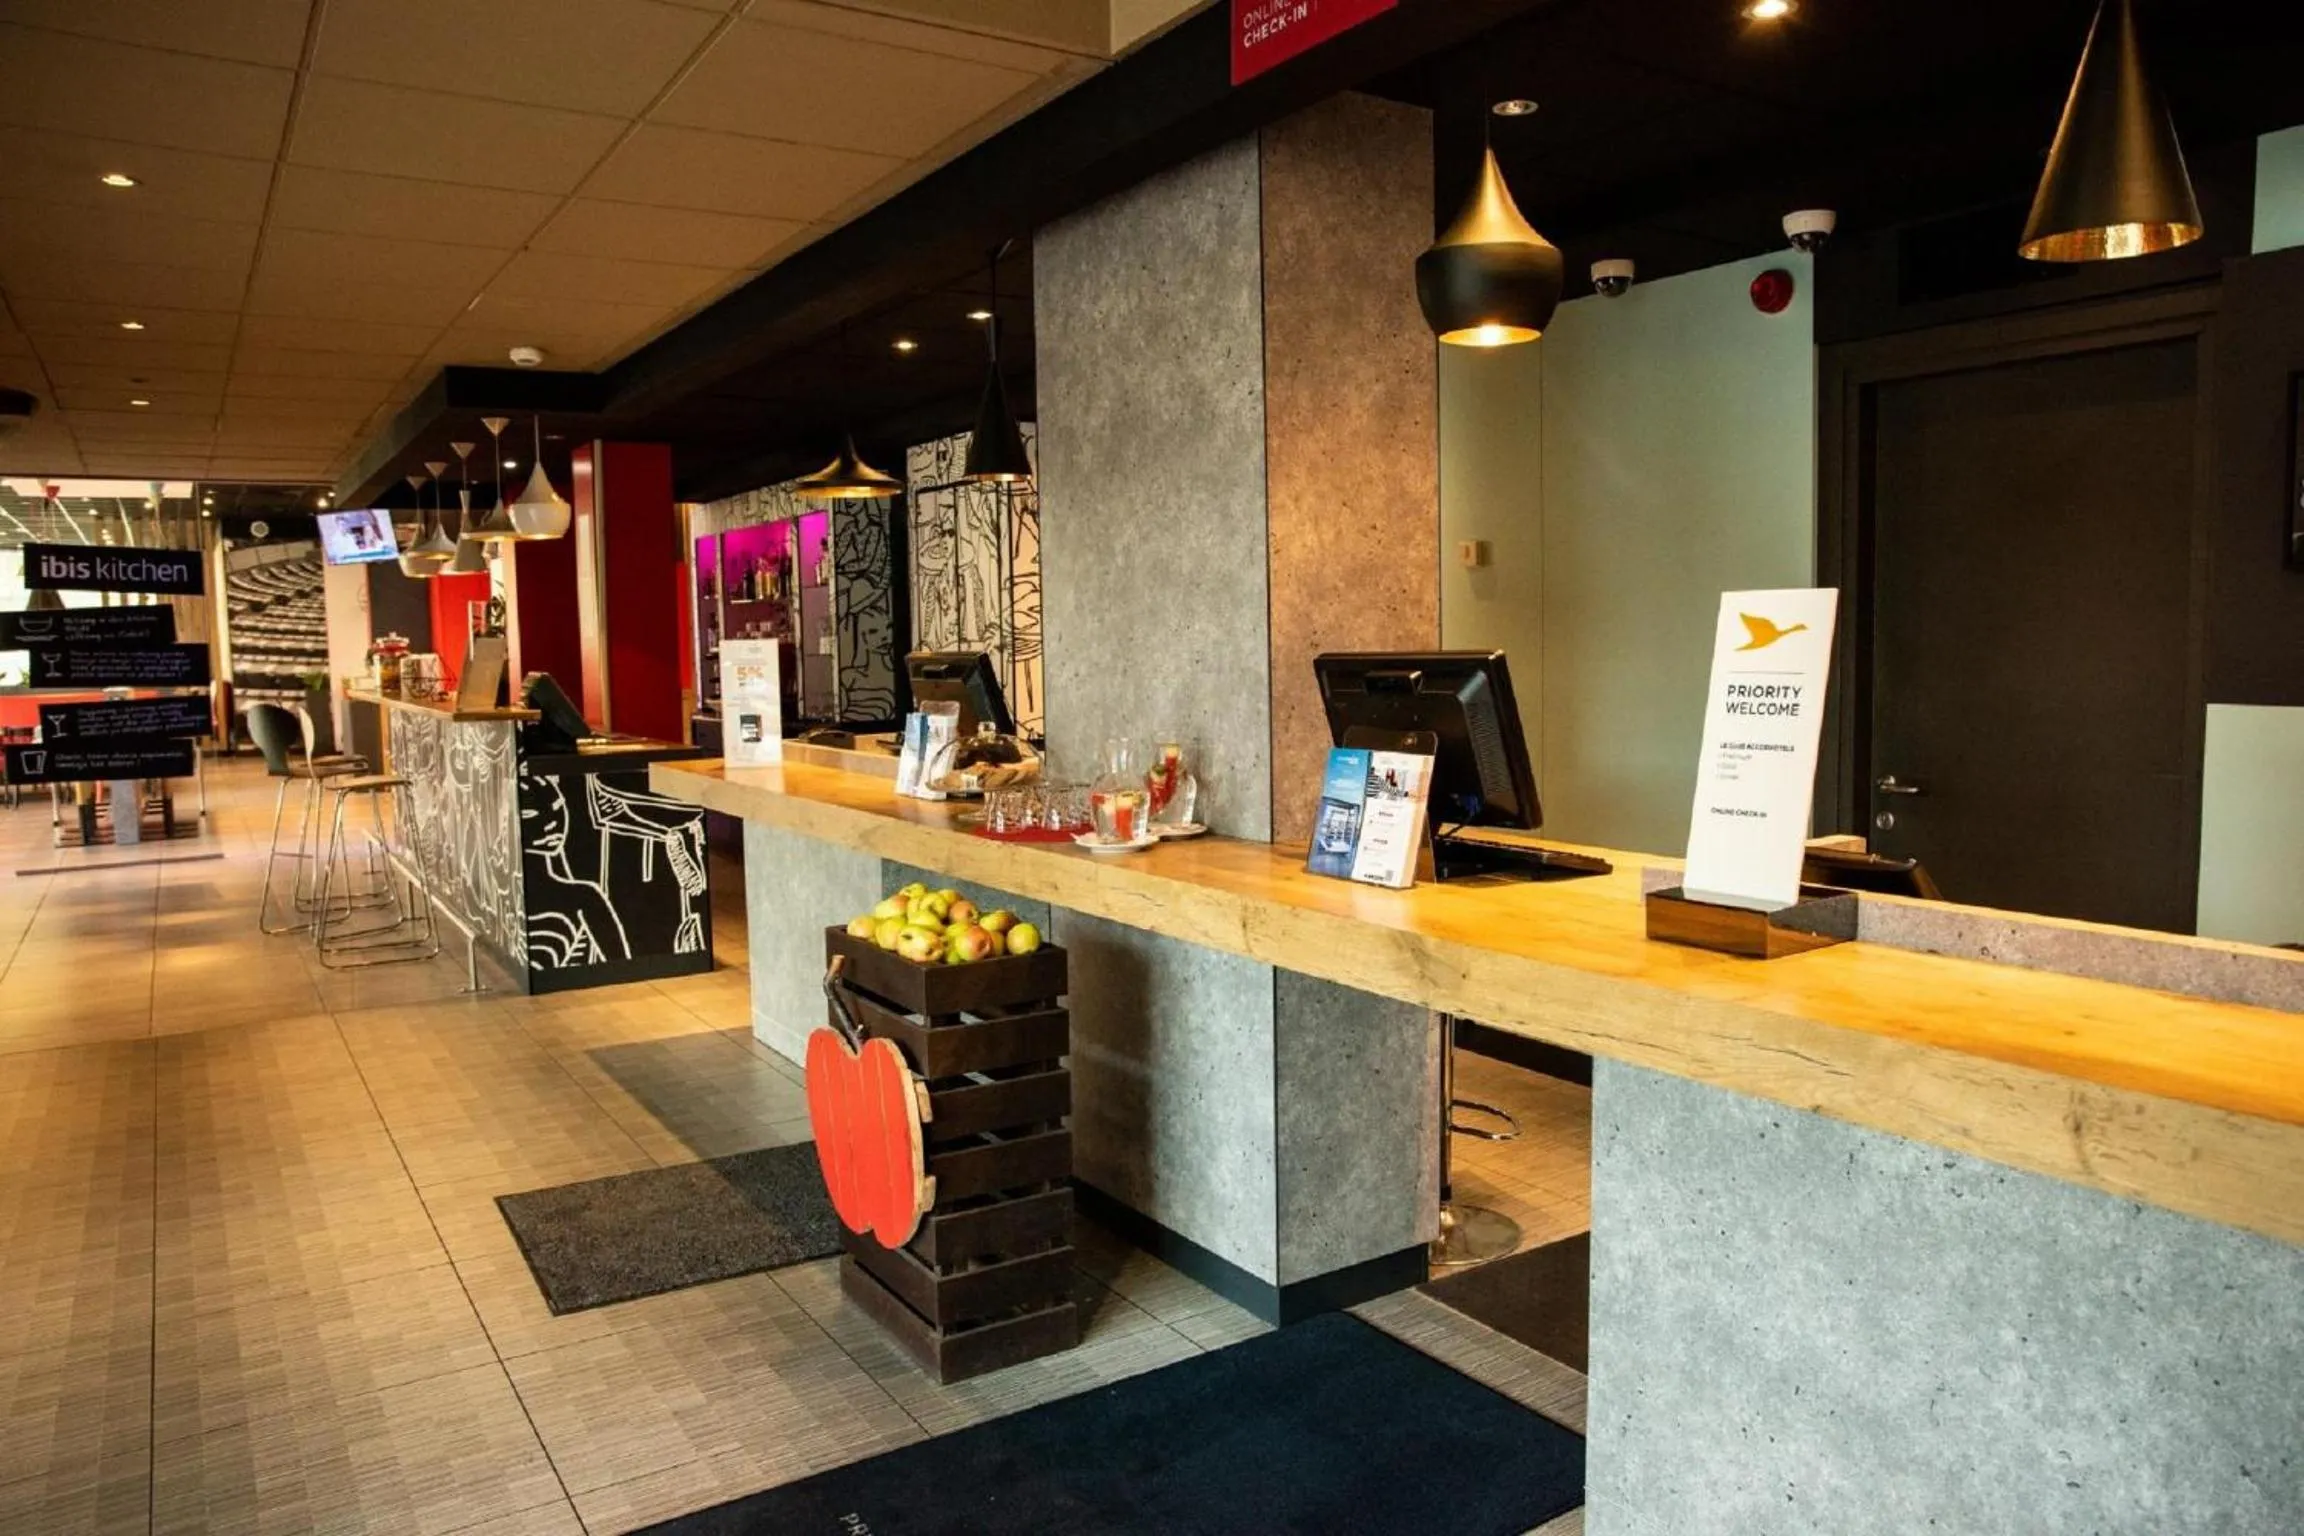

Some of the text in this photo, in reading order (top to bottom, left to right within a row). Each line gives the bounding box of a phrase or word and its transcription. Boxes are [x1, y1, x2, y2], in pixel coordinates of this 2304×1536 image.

[1243, 1, 1308, 48] CHECK-IN
[41, 554, 189, 583] ibis kitchen
[1727, 684, 1802, 698] PRIORITY
[1726, 701, 1801, 717] WELCOME
[838, 1512, 874, 1536] PR
